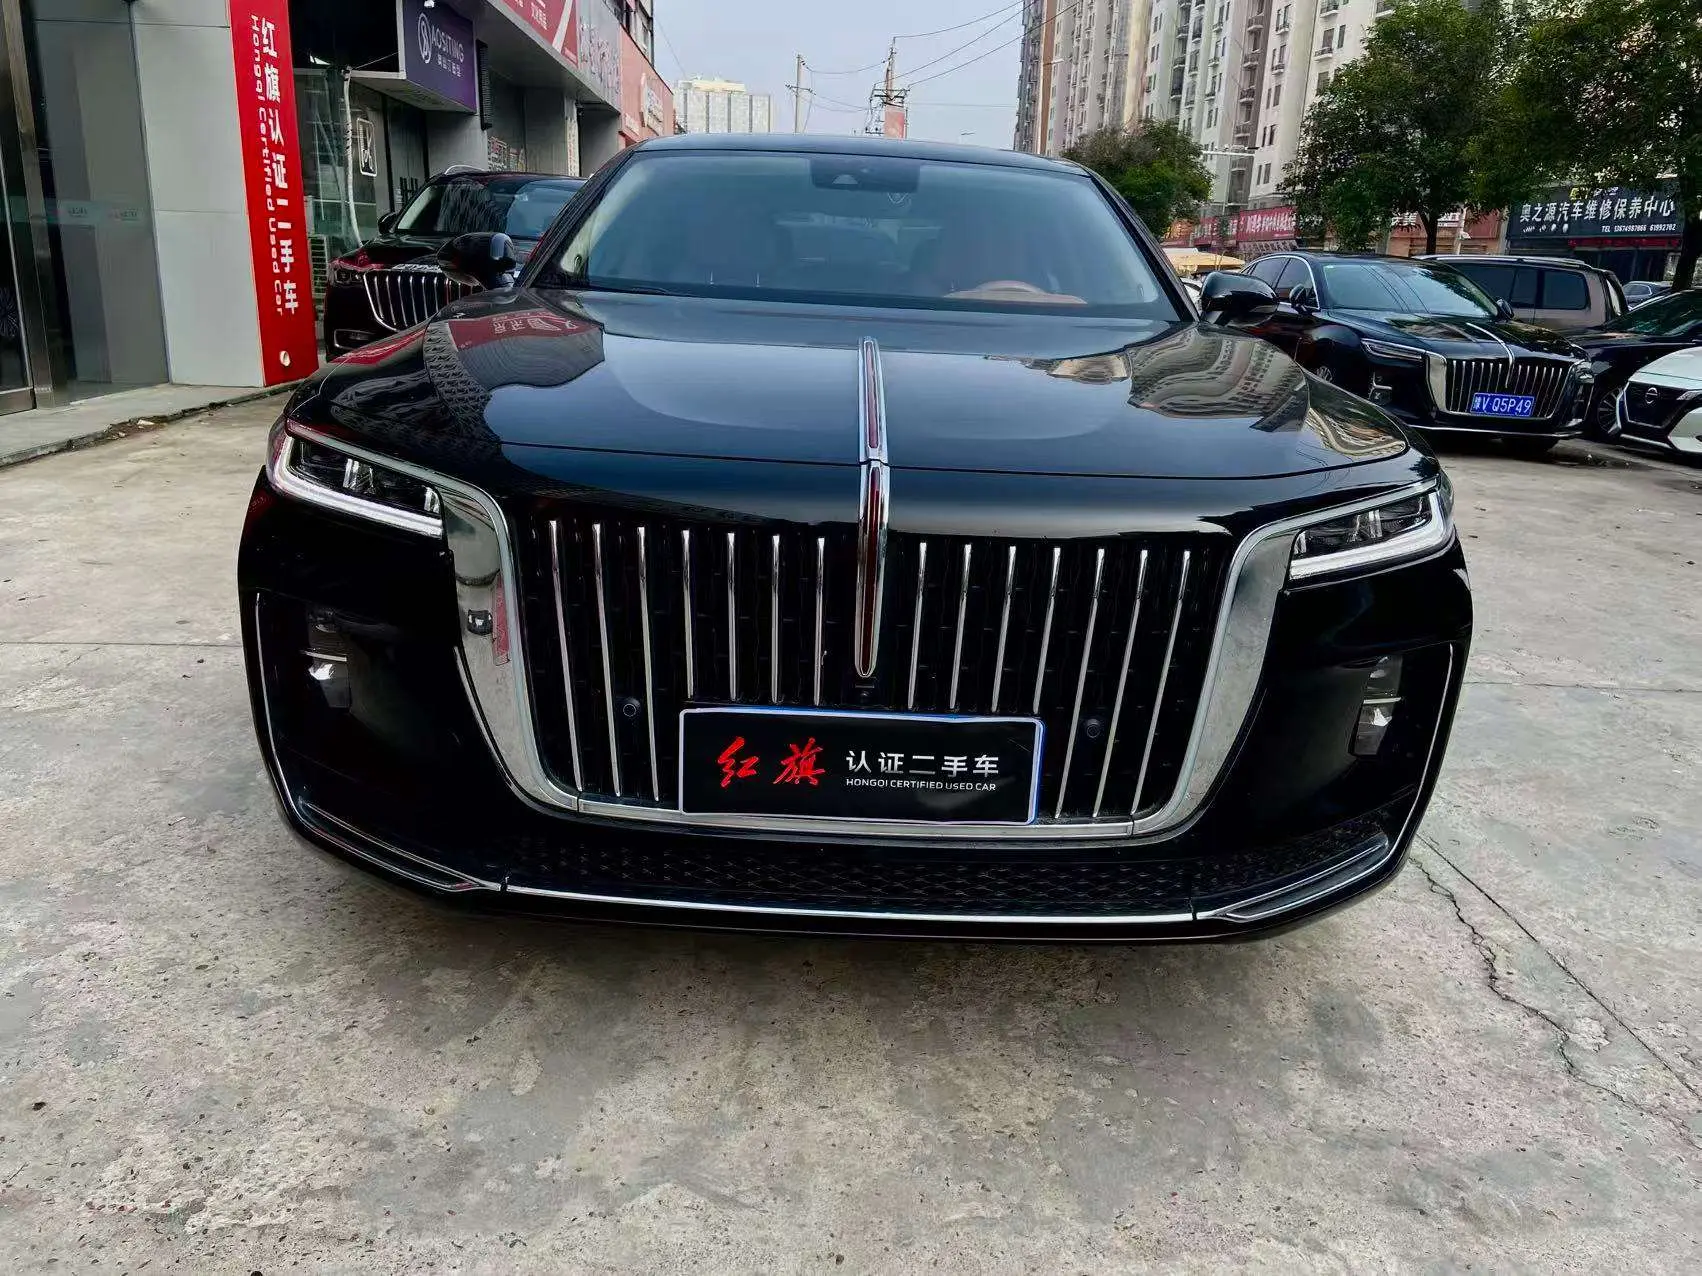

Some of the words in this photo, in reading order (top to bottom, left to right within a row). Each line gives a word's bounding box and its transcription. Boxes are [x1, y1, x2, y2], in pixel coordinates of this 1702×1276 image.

[258, 107, 276, 211] Certified
[261, 17, 299, 315] 红旗认证二手车
[1519, 195, 1676, 223] 奥之源汽车维修保养中心
[1601, 225, 1611, 233] TEL
[268, 217, 281, 274] Used
[274, 279, 283, 317] Car
[717, 735, 826, 789] 红旗
[845, 750, 999, 778] 认证二手车
[890, 779, 944, 790] CERTIFIED
[945, 782, 974, 791] USED
[975, 782, 997, 791] CAR
